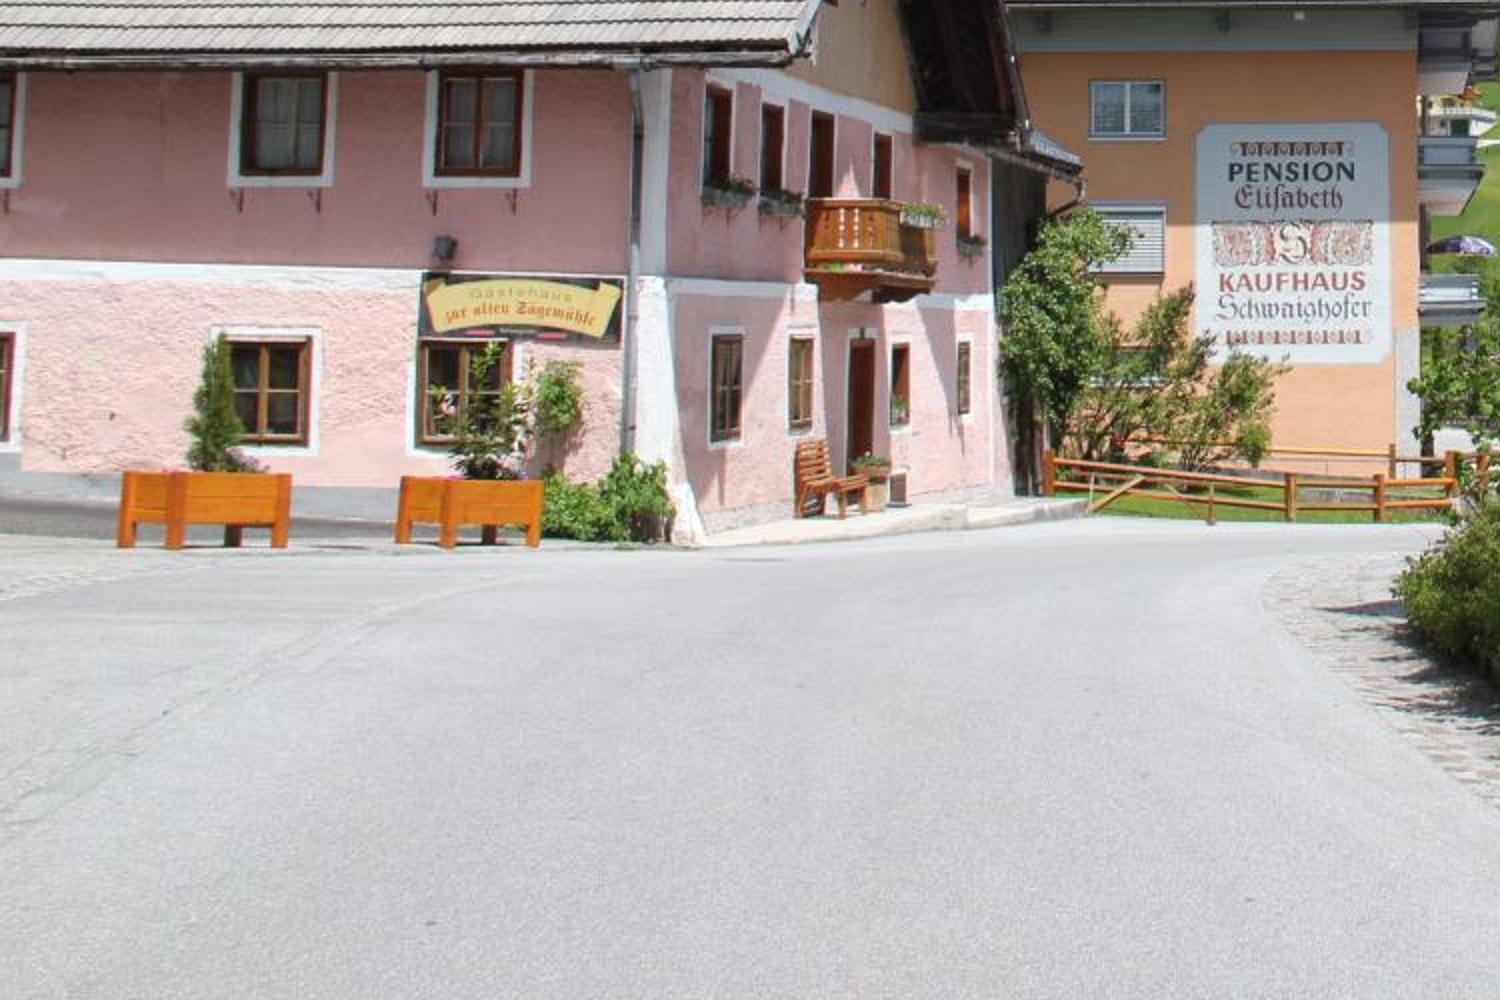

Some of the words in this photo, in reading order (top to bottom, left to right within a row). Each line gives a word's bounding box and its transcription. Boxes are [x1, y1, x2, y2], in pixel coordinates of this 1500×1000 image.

[1228, 161, 1355, 182] PENSION
[1219, 271, 1366, 292] KAUFHAUS
[473, 301, 509, 316] alten
[1215, 293, 1372, 324] Schwaighofer
